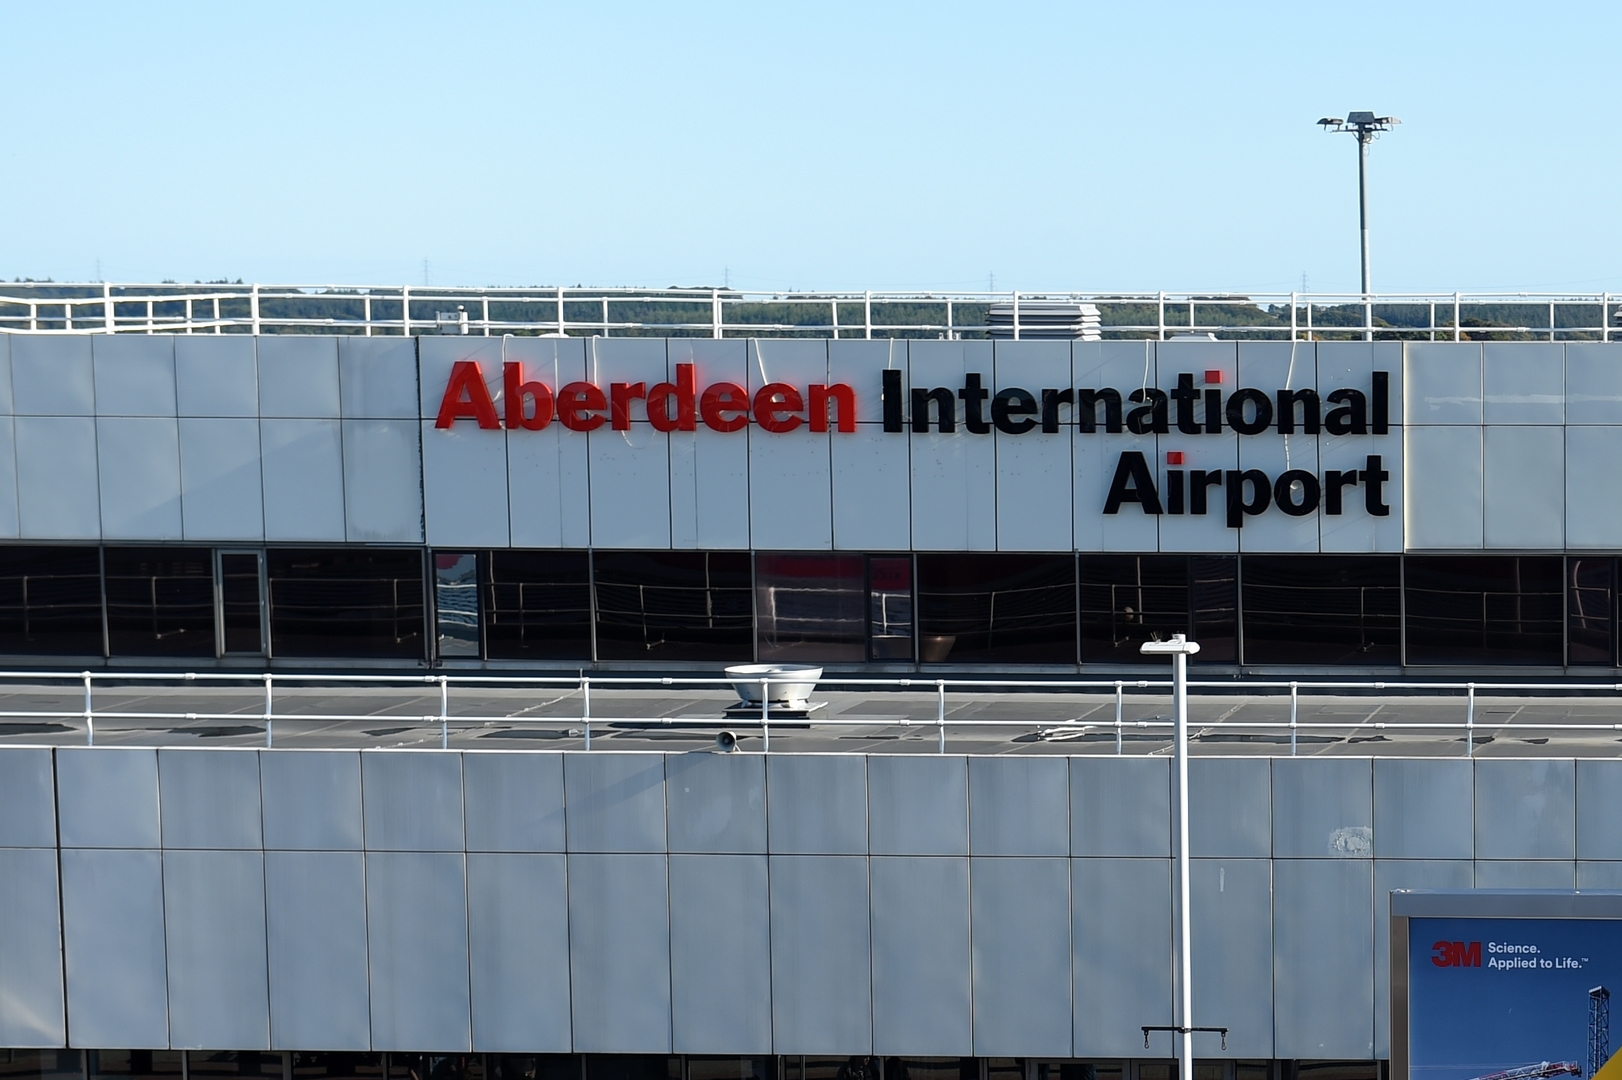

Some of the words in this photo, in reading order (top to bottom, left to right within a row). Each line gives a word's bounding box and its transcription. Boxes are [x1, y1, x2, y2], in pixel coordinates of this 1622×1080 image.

[434, 361, 856, 433] Aberdeen
[882, 369, 1389, 436] International
[1103, 451, 1389, 528] Airport
[1431, 940, 1481, 967] 3M
[1488, 942, 1540, 954] Science.
[1488, 957, 1537, 970] Applied
[1539, 958, 1553, 968] to
